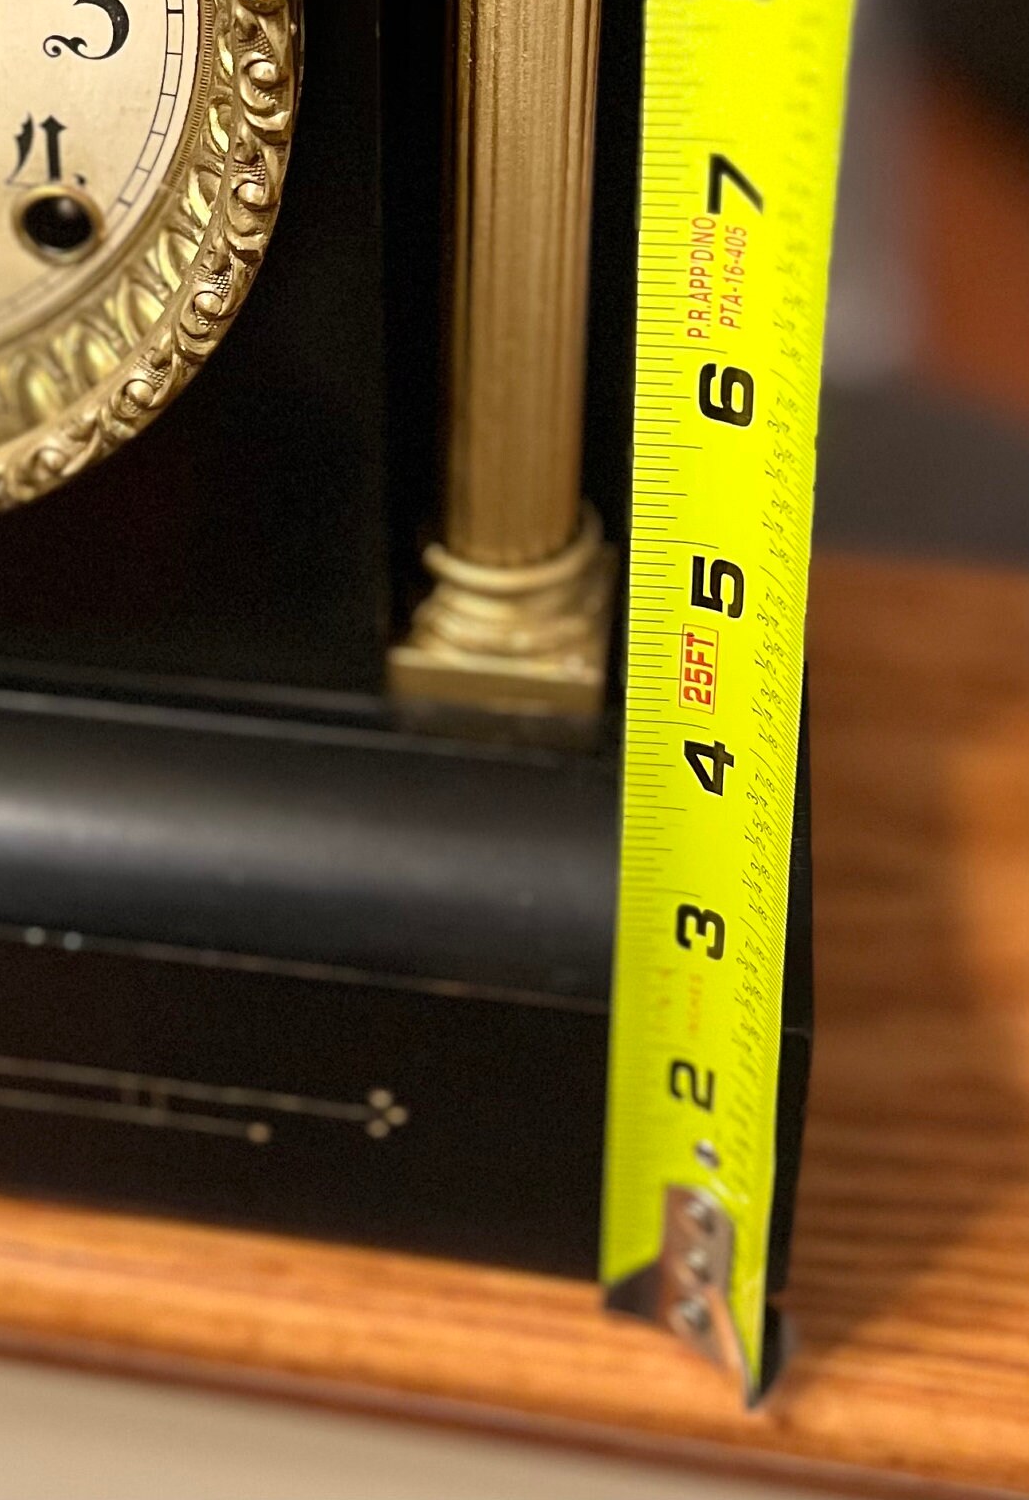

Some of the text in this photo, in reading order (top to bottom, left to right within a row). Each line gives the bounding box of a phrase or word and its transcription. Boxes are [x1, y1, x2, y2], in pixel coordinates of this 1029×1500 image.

[707, 153, 764, 215] 7
[719, 225, 748, 330] PTA-16-405
[699, 363, 754, 427] 6
[691, 555, 744, 618] 5
[683, 631, 715, 705] 25FT
[684, 740, 734, 796] 4
[676, 903, 725, 960] 3
[670, 1059, 715, 1114] 2
